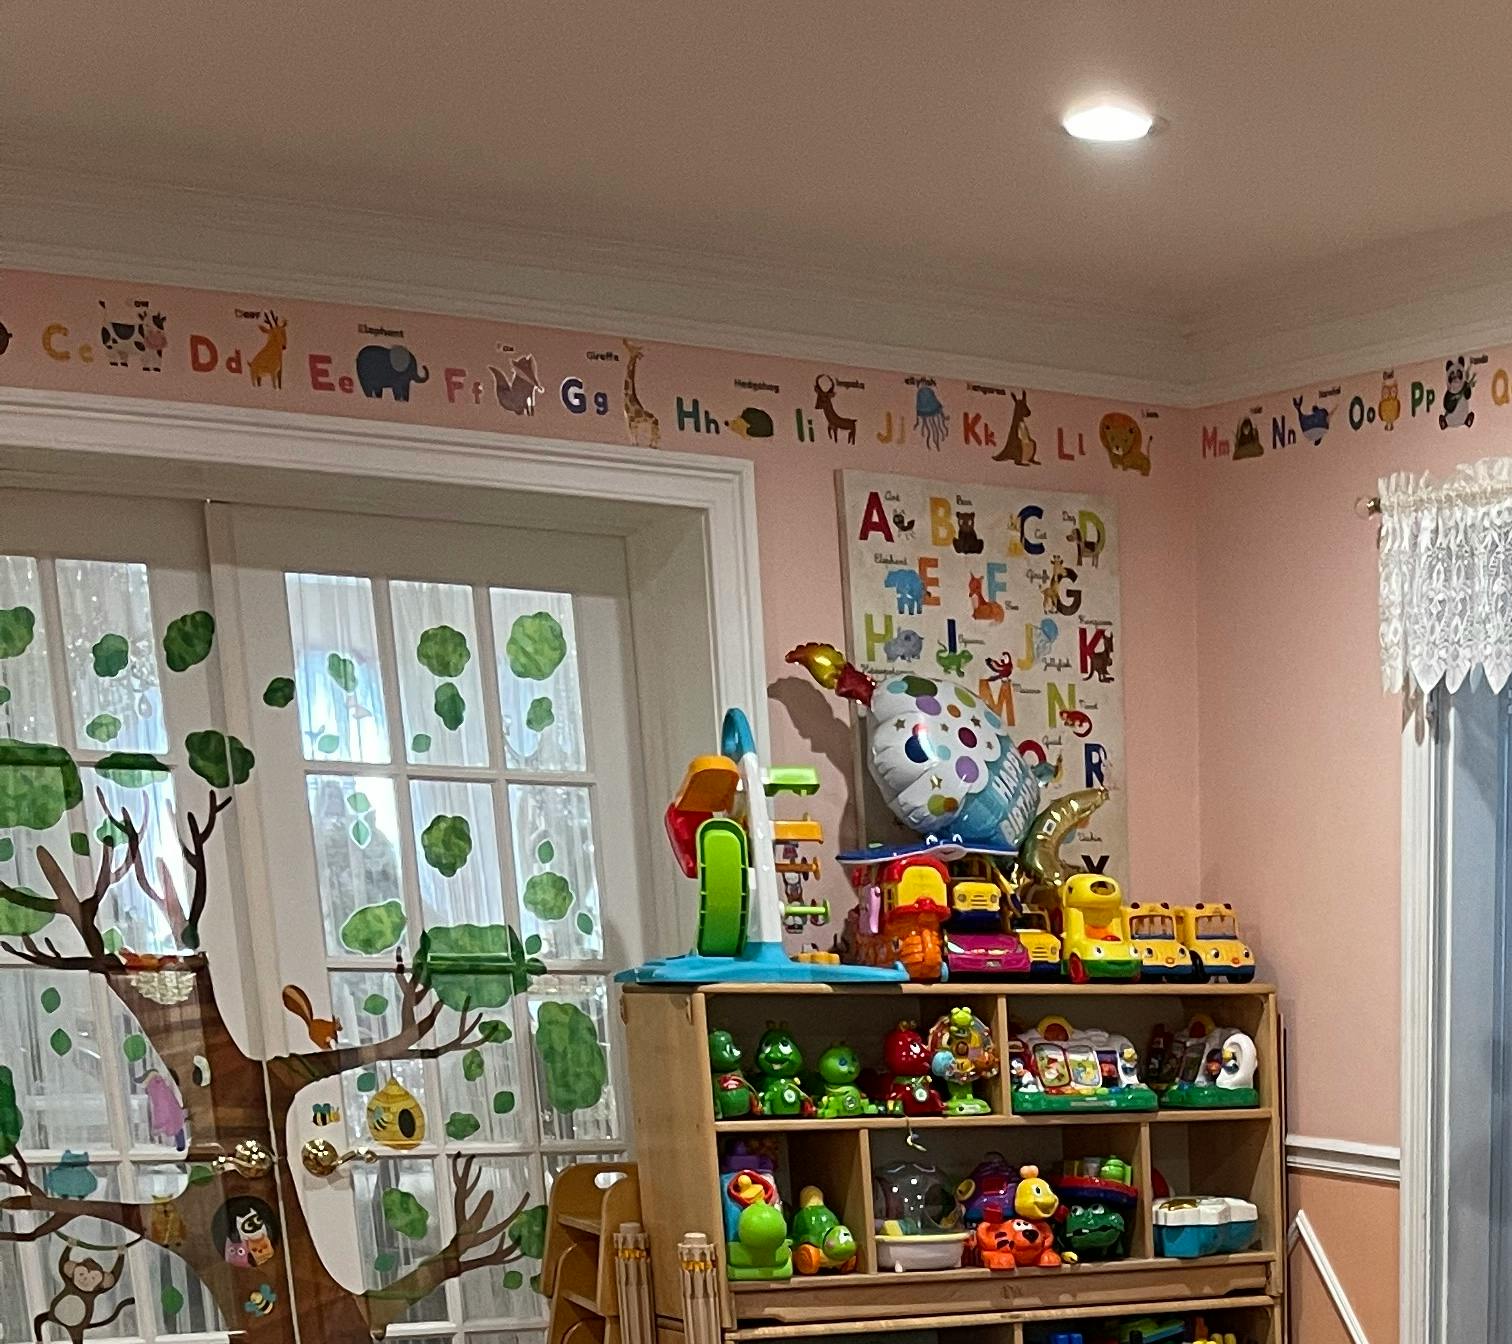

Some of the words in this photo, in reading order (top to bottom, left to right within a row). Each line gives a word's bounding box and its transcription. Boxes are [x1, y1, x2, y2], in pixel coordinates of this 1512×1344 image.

[190, 334, 242, 374] Dd
[309, 354, 355, 395] Ee
[560, 377, 608, 416] Gg
[676, 397, 721, 436] Hh
[963, 412, 997, 447] Kk
[1272, 415, 1296, 449] Nn
[1349, 396, 1376, 431] Oo
[1411, 382, 1435, 417] Pp
[859, 491, 894, 543] A
[929, 497, 957, 546] B
[1017, 505, 1045, 555] C
[1078, 510, 1106, 553] D
[918, 557, 941, 606] E
[986, 562, 1007, 602] F
[1057, 567, 1082, 616] G
[864, 613, 894, 662] H
[1017, 623, 1034, 671] J
[1078, 627, 1107, 674] K
[979, 678, 1016, 727] M
[1047, 682, 1076, 728] N
[1084, 743, 1108, 788] R
